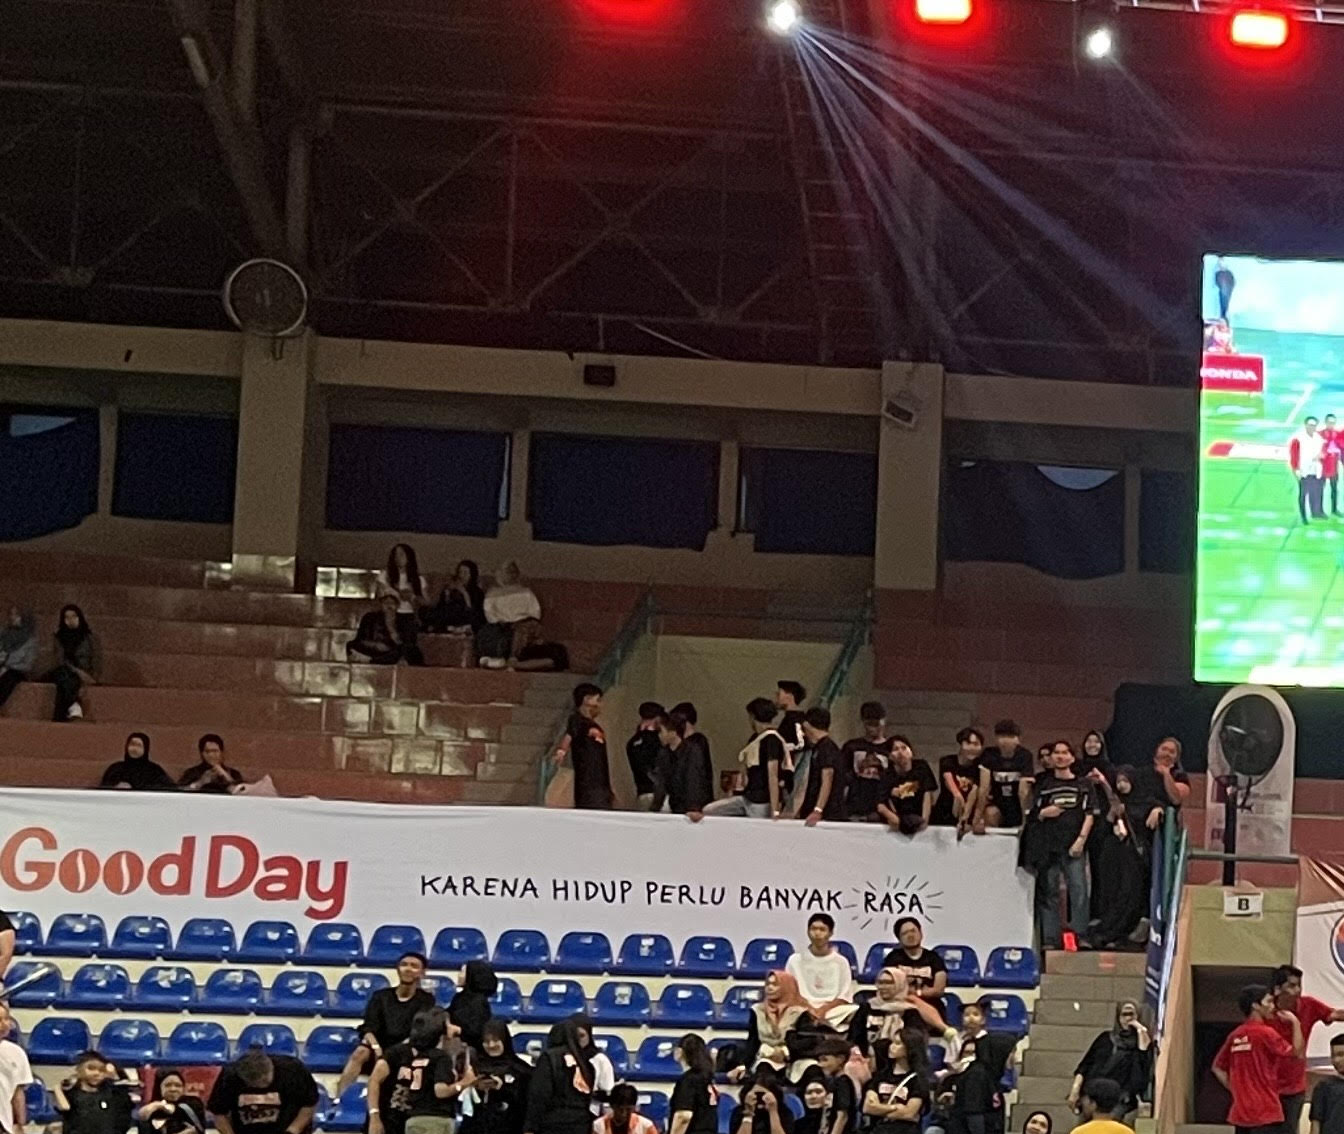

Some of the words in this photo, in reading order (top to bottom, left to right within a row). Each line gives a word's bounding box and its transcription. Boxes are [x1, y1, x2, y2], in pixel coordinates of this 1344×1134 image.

[421, 875, 539, 899] KARENA
[552, 879, 633, 904] HIDUP
[646, 882, 726, 906] PERLU
[740, 884, 843, 911] BANYAK
[863, 890, 924, 915] RASA
[1238, 898, 1250, 911] B
